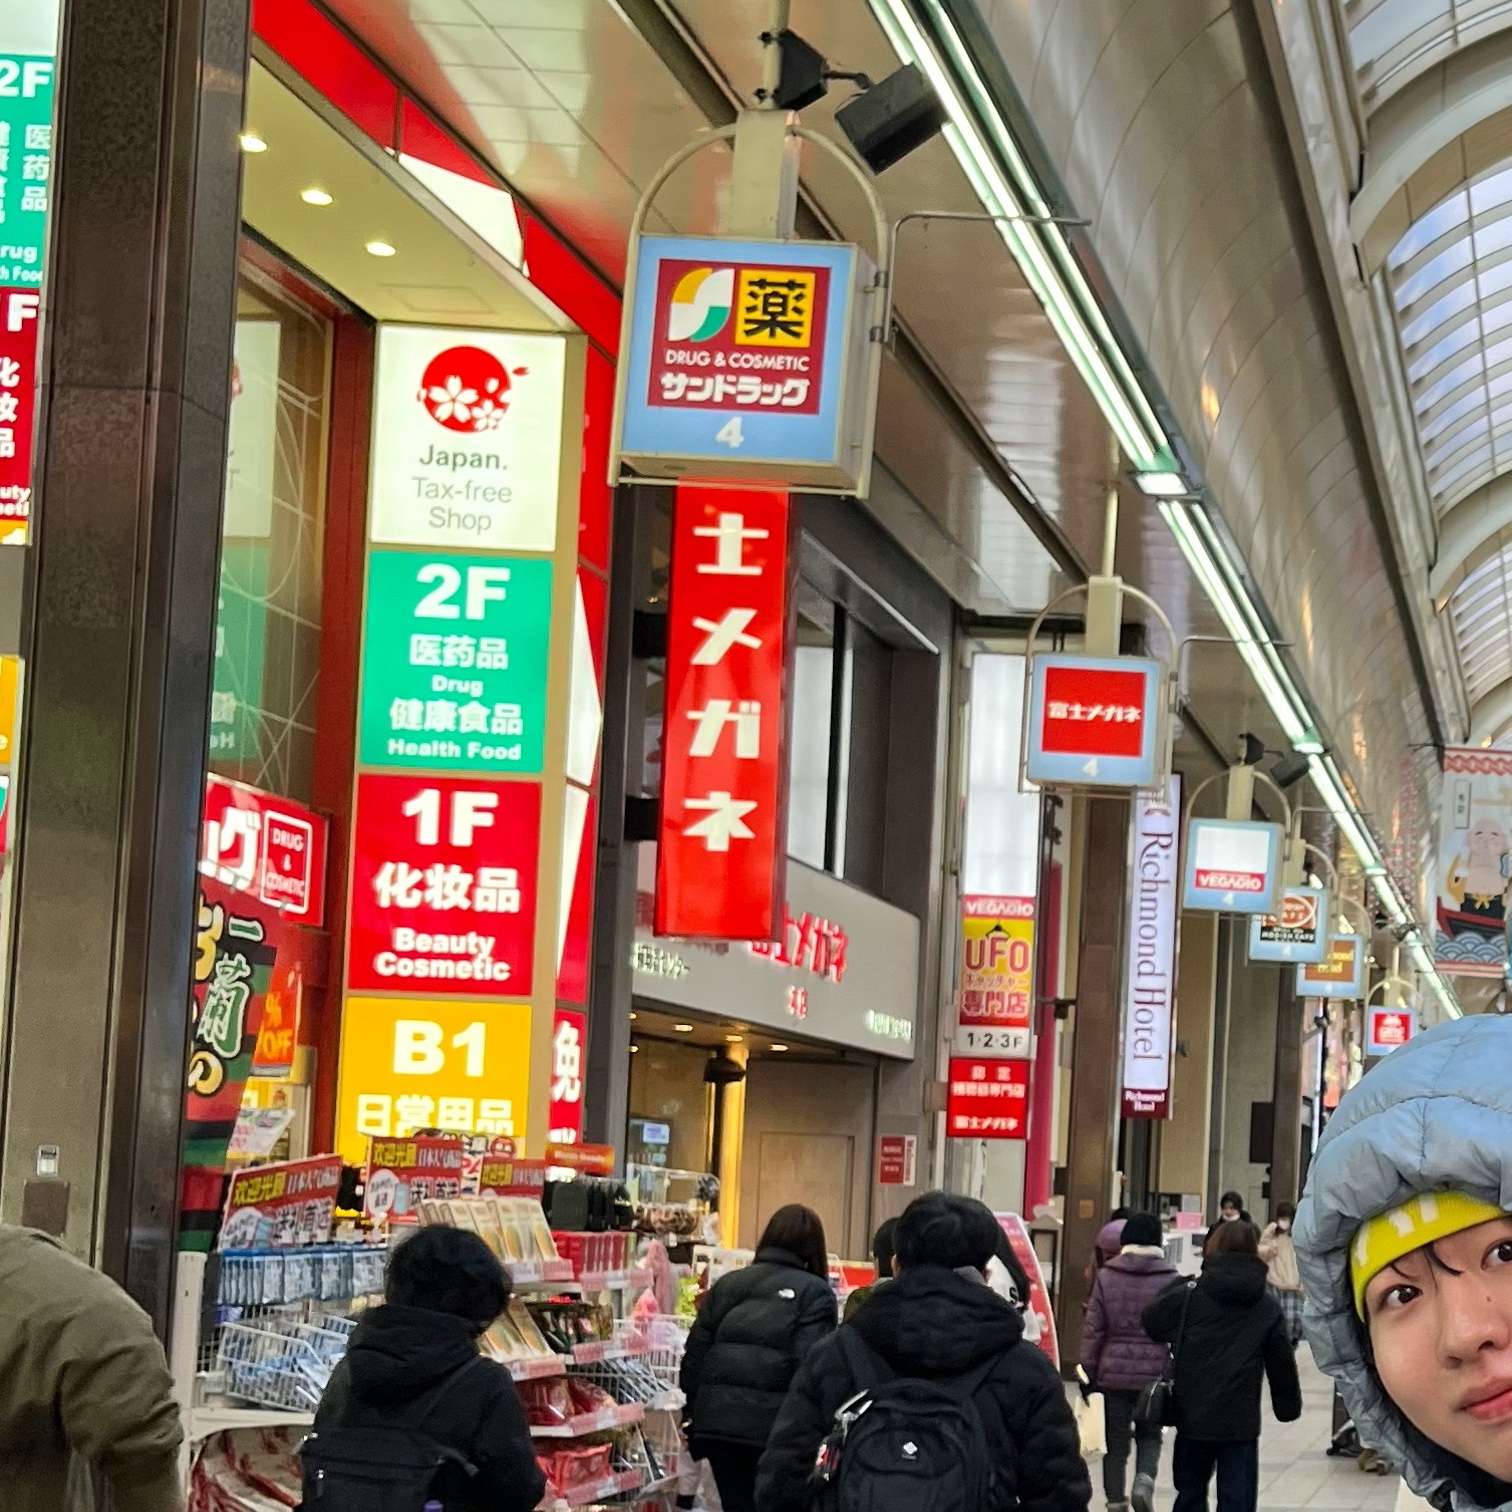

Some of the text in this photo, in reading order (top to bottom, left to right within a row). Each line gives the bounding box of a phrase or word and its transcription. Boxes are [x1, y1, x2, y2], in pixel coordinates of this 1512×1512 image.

[743, 278, 808, 338] 薬
[665, 348, 809, 371] DRUG & COSMETIC
[661, 372, 811, 407] サンドラッグ
[715, 416, 745, 448] 4
[418, 445, 509, 471] Japan.
[411, 477, 512, 501] Tax-free
[429, 508, 492, 534] Shop
[413, 564, 511, 620] 2F
[409, 635, 509, 670] 医药品
[432, 675, 484, 698] Drug
[389, 700, 523, 737] 健康食品
[1048, 701, 1142, 724] 富士メガネ
[388, 740, 521, 761] Health Food
[1081, 758, 1099, 777] 4
[402, 791, 499, 848] 1F
[271, 827, 304, 852] DRUG
[265, 872, 304, 898] COSMETIC
[375, 863, 520, 914] 化妆品
[394, 928, 496, 959] Beauty
[965, 935, 1030, 974] UFO
[1133, 831, 1174, 1061] Richmond Hotel
[376, 955, 510, 981] Cosmetic
[392, 1020, 486, 1078] B1
